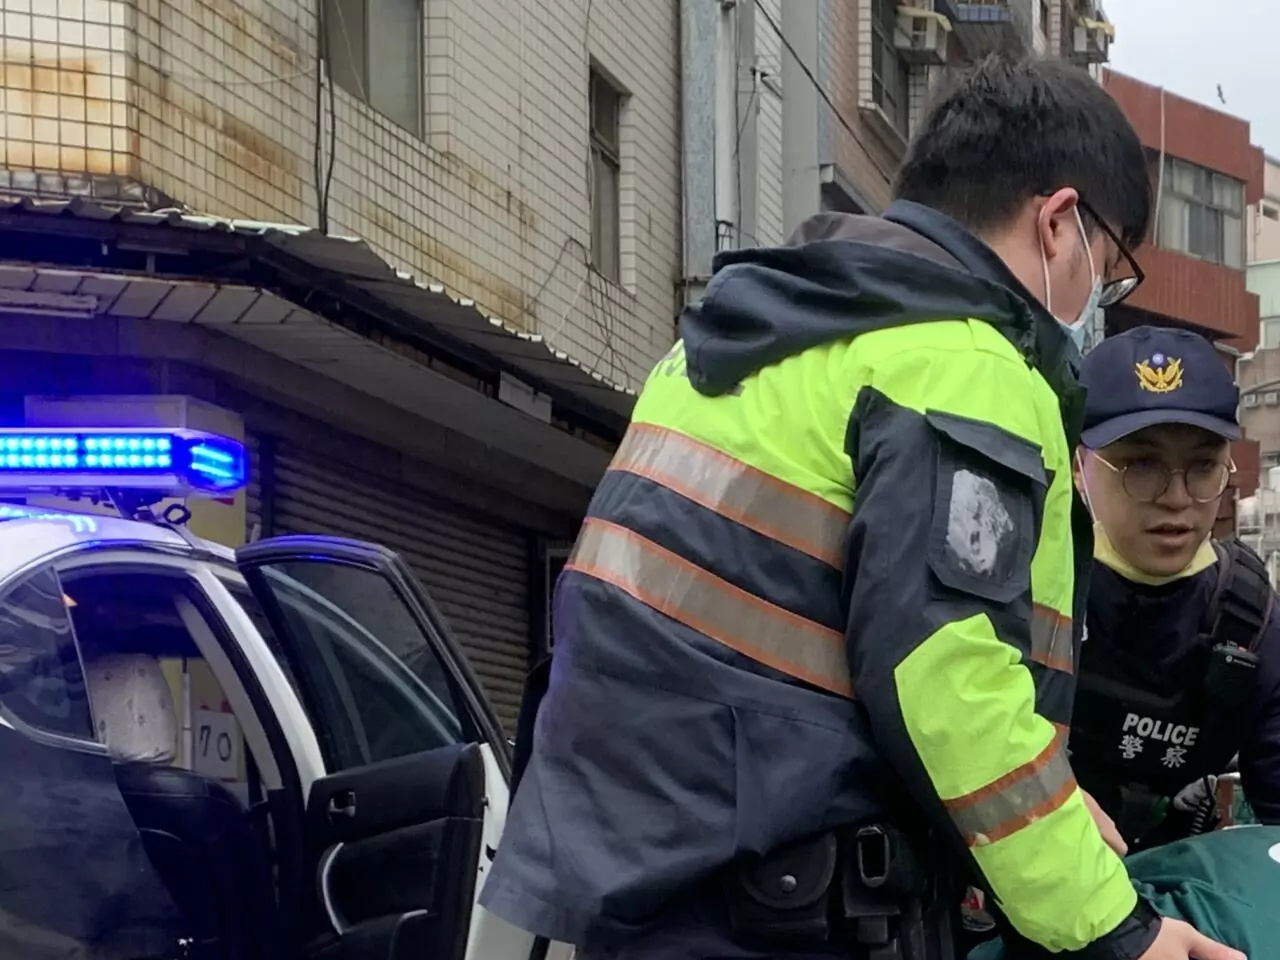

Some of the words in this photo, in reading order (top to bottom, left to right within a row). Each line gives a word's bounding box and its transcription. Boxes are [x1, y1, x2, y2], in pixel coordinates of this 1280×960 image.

[200, 725, 232, 762] 70
[1122, 712, 1200, 746] POLICE
[1118, 734, 1188, 768] 警察
